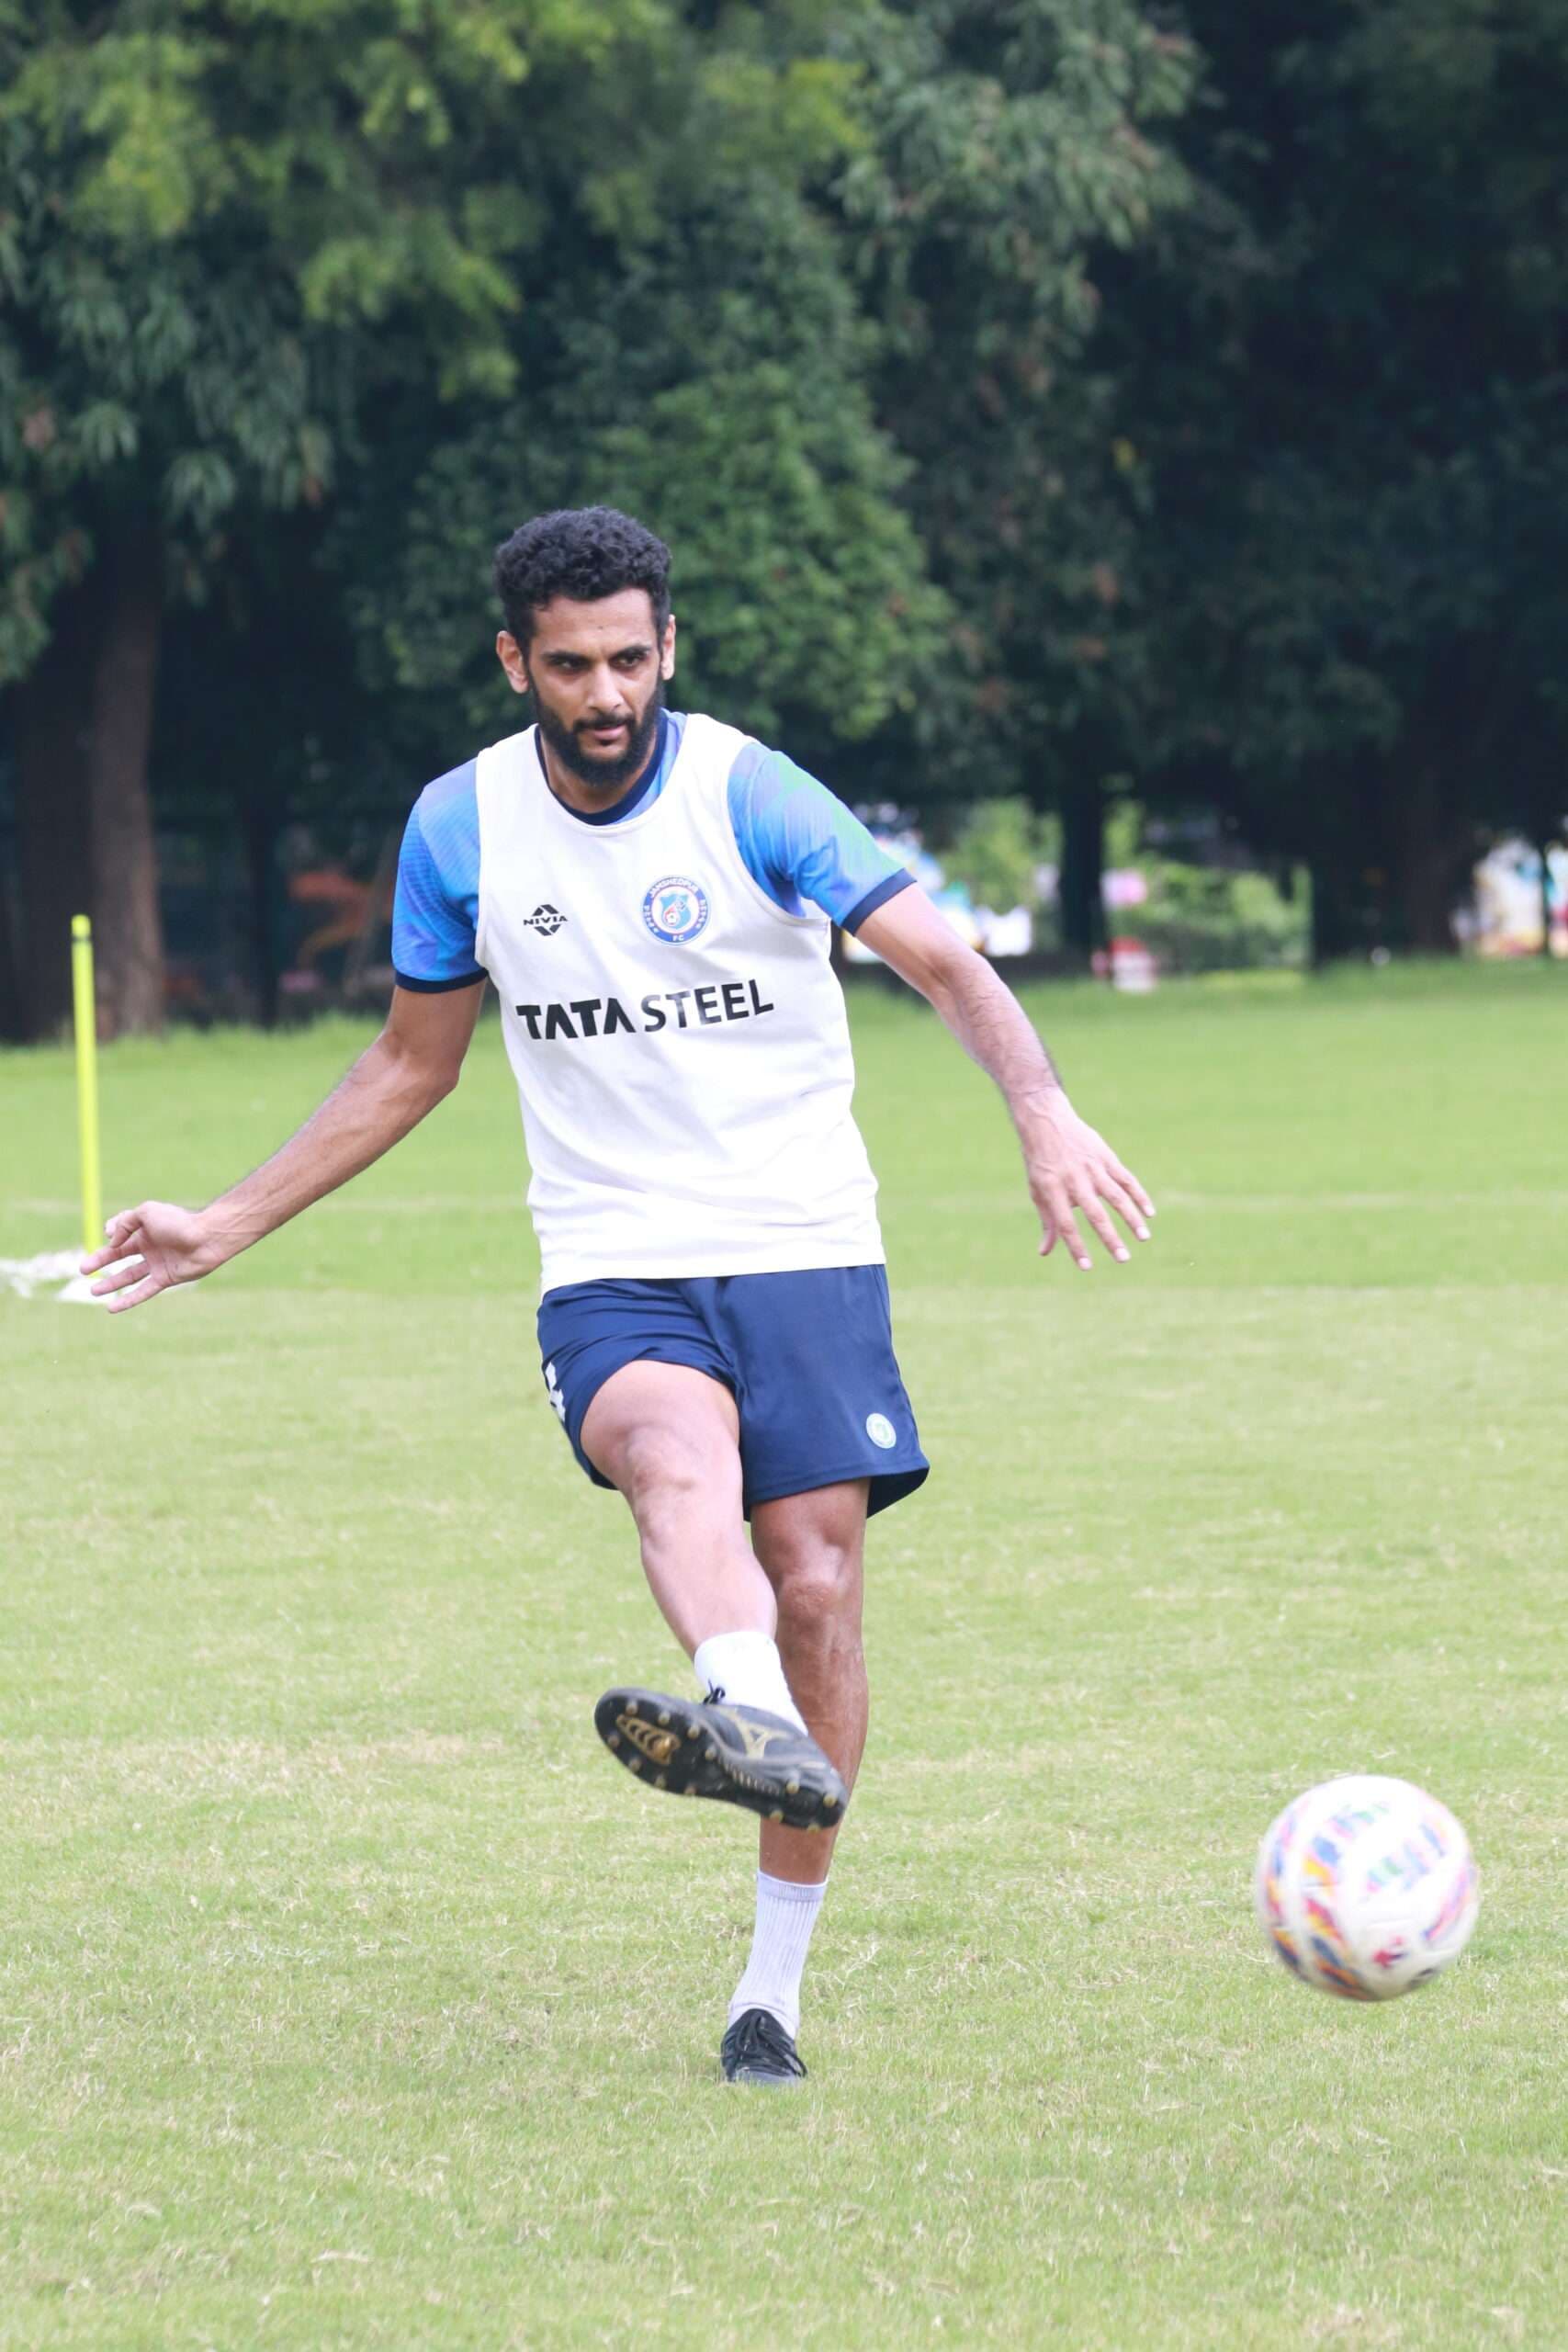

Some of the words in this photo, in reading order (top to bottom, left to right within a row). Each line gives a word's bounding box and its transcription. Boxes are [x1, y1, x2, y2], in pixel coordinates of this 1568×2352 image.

[524, 916, 568, 925] NIVIA
[515, 997, 637, 1040] TATA
[640, 978, 774, 1033] STEEL
